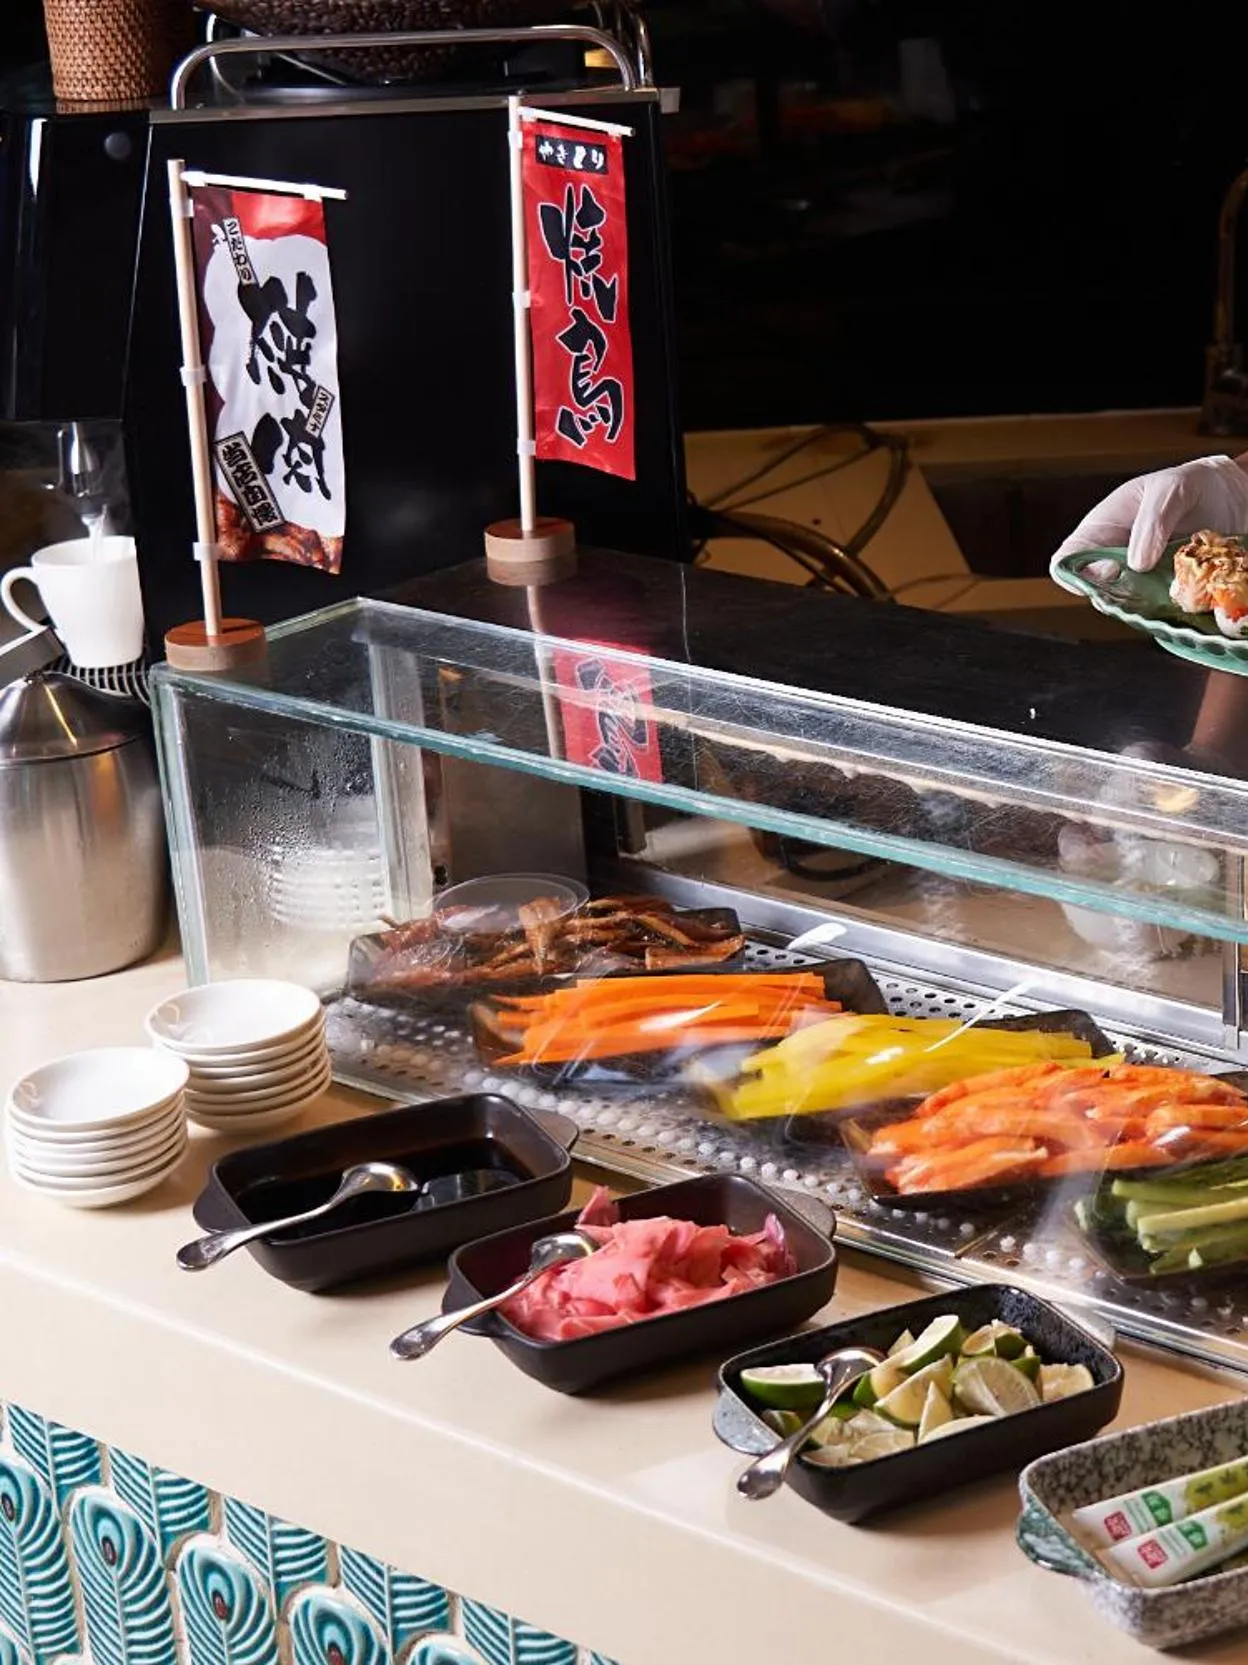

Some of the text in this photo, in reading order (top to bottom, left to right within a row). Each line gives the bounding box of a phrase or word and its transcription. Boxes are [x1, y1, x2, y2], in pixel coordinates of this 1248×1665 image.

[538, 140, 605, 170] やきとり
[538, 183, 625, 447] 焼鳥
